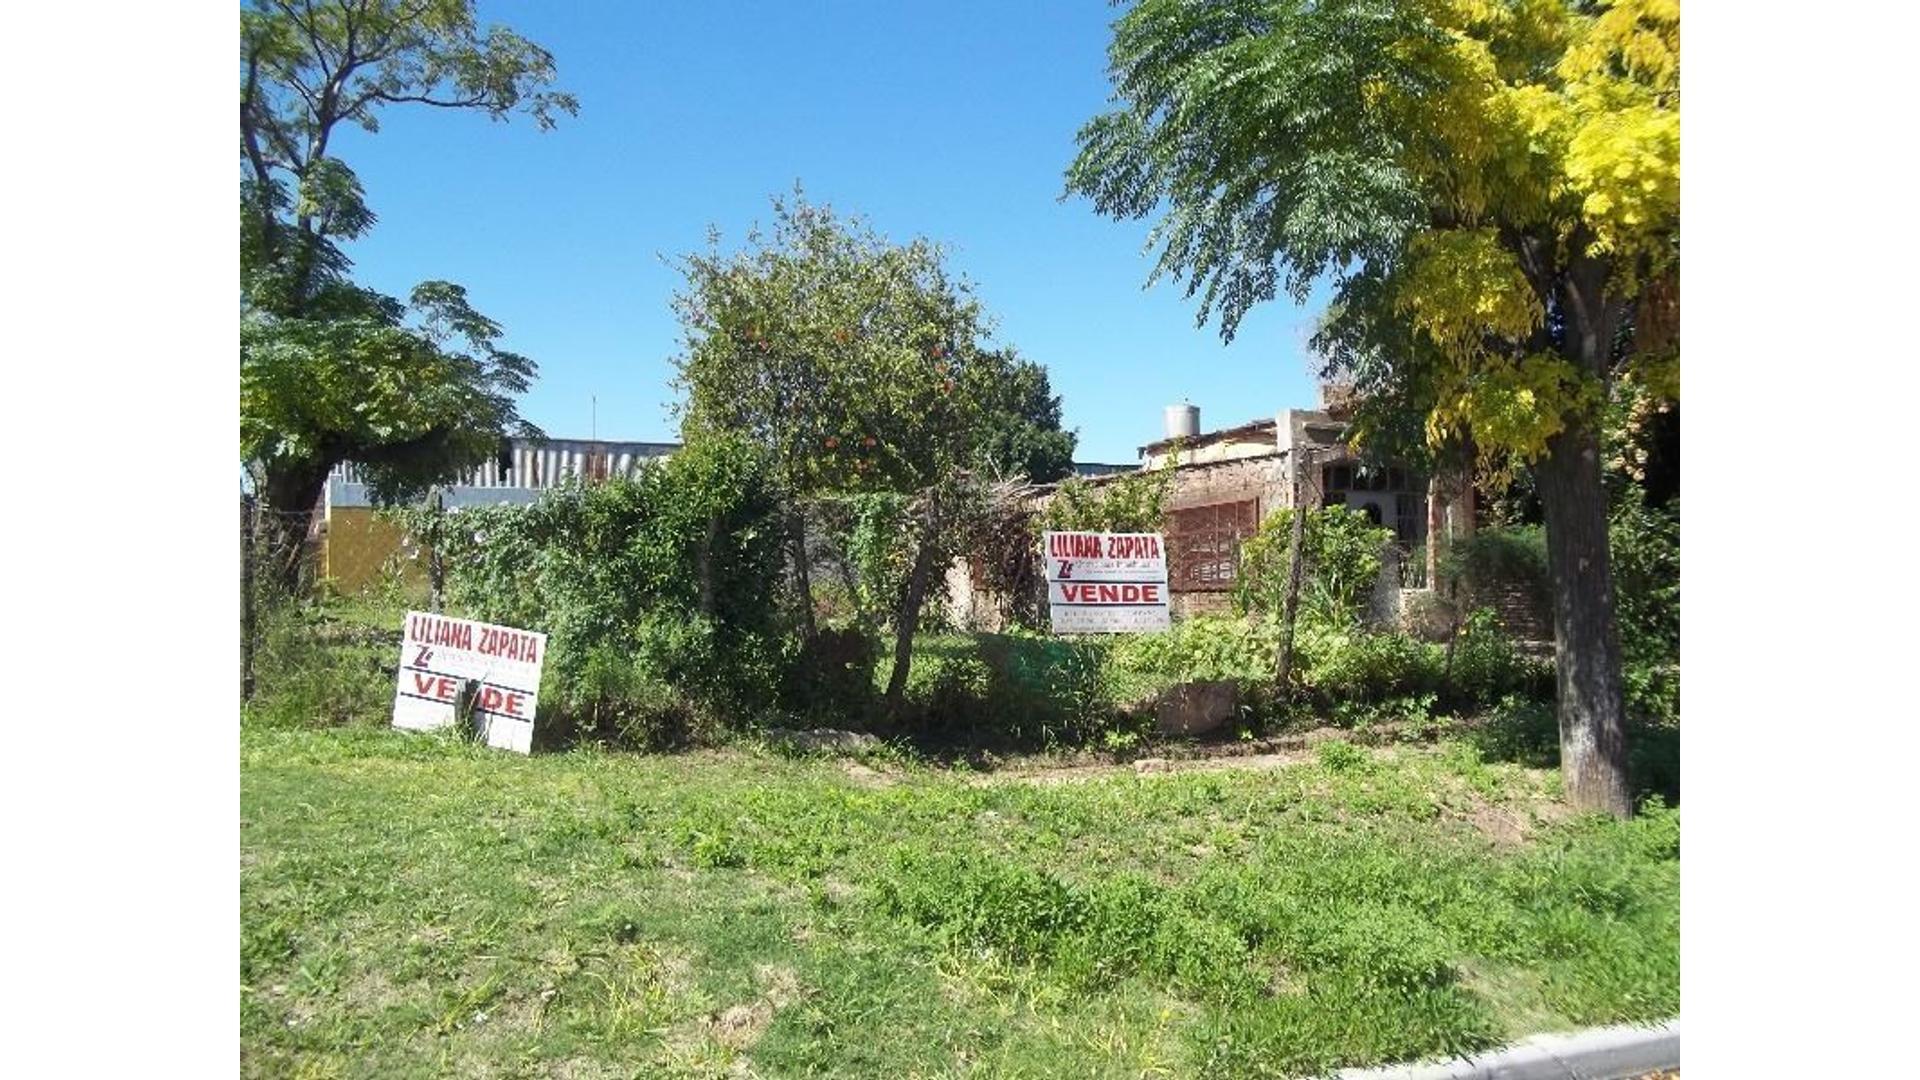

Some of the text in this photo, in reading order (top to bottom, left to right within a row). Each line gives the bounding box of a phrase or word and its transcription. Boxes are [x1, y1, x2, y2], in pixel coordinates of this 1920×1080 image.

[1050, 535, 1160, 559] LILIANA ZAPATA
[1061, 585, 1159, 602] VENDE
[411, 616, 472, 651] LILIANA
[478, 628, 538, 664] ZAPATA
[414, 673, 525, 715] VEDE
